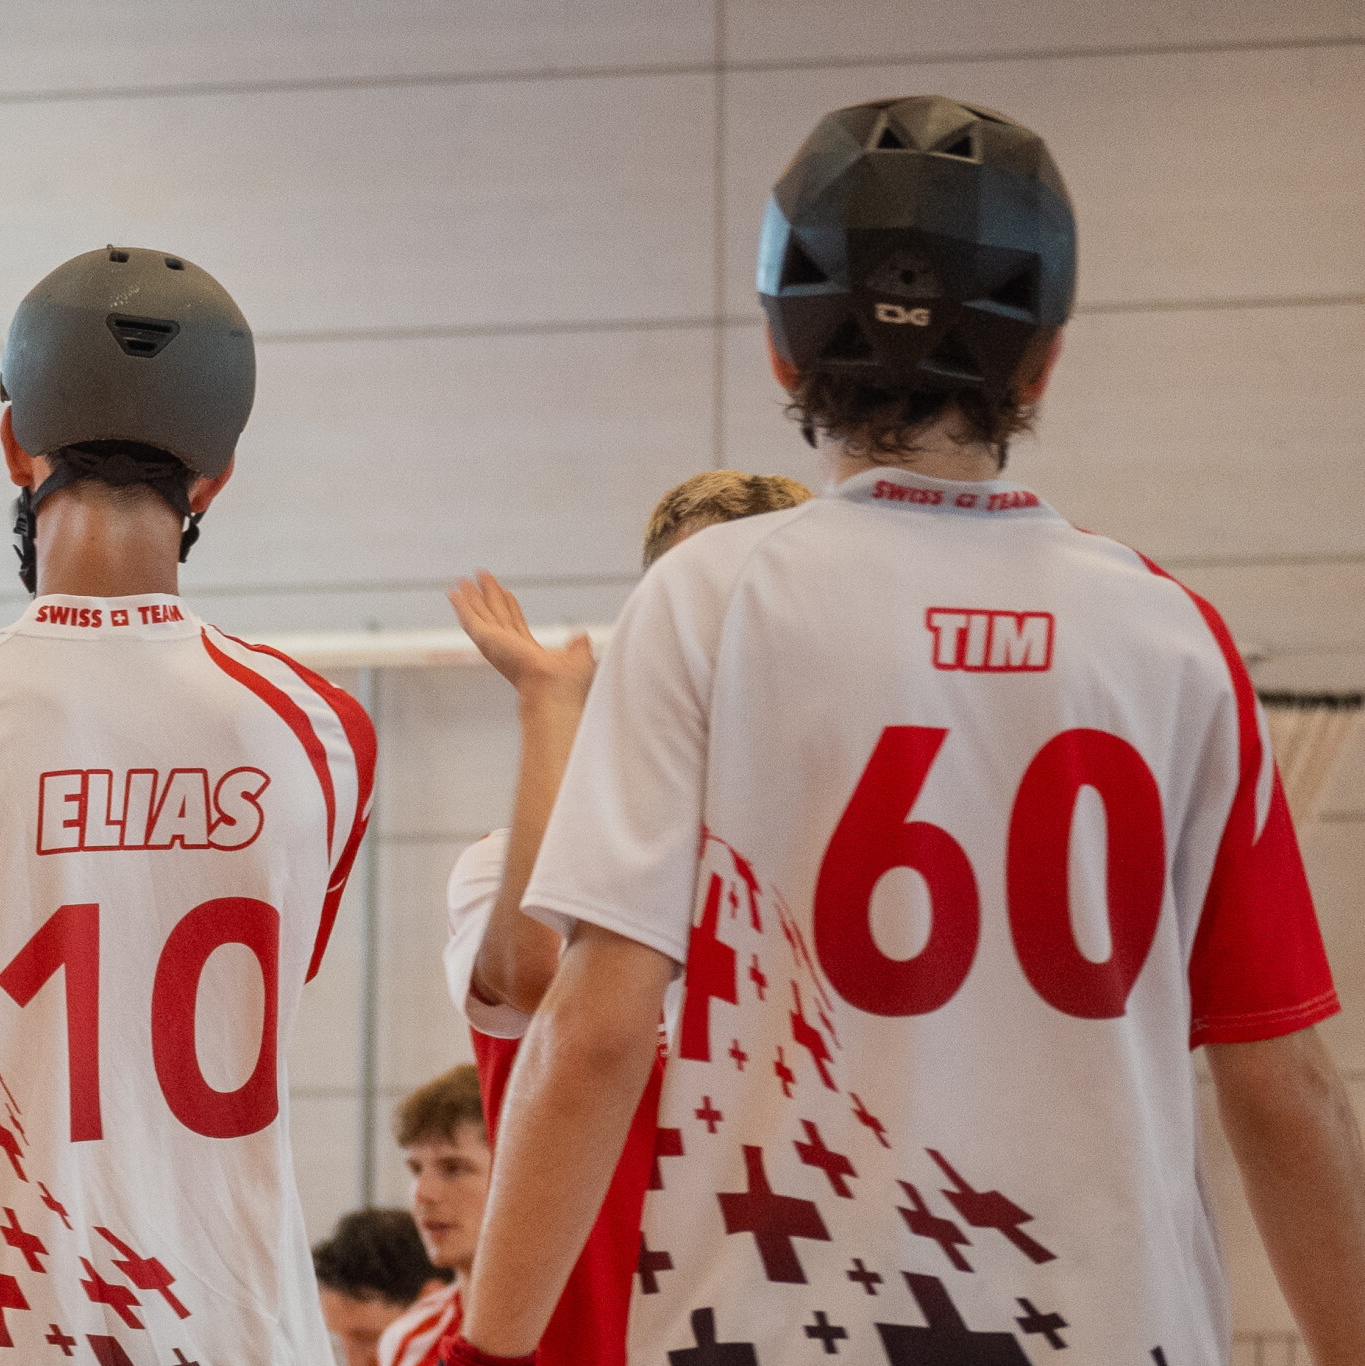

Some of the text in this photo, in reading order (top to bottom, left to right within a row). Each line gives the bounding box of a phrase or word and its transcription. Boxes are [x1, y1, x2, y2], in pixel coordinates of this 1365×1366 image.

[873, 480, 1040, 511] SWISS TEAM
[35, 604, 185, 628] SWISS TEAM
[925, 606, 1055, 674] TIM
[35, 766, 272, 856] ELIAS
[814, 725, 1167, 1020] 60
